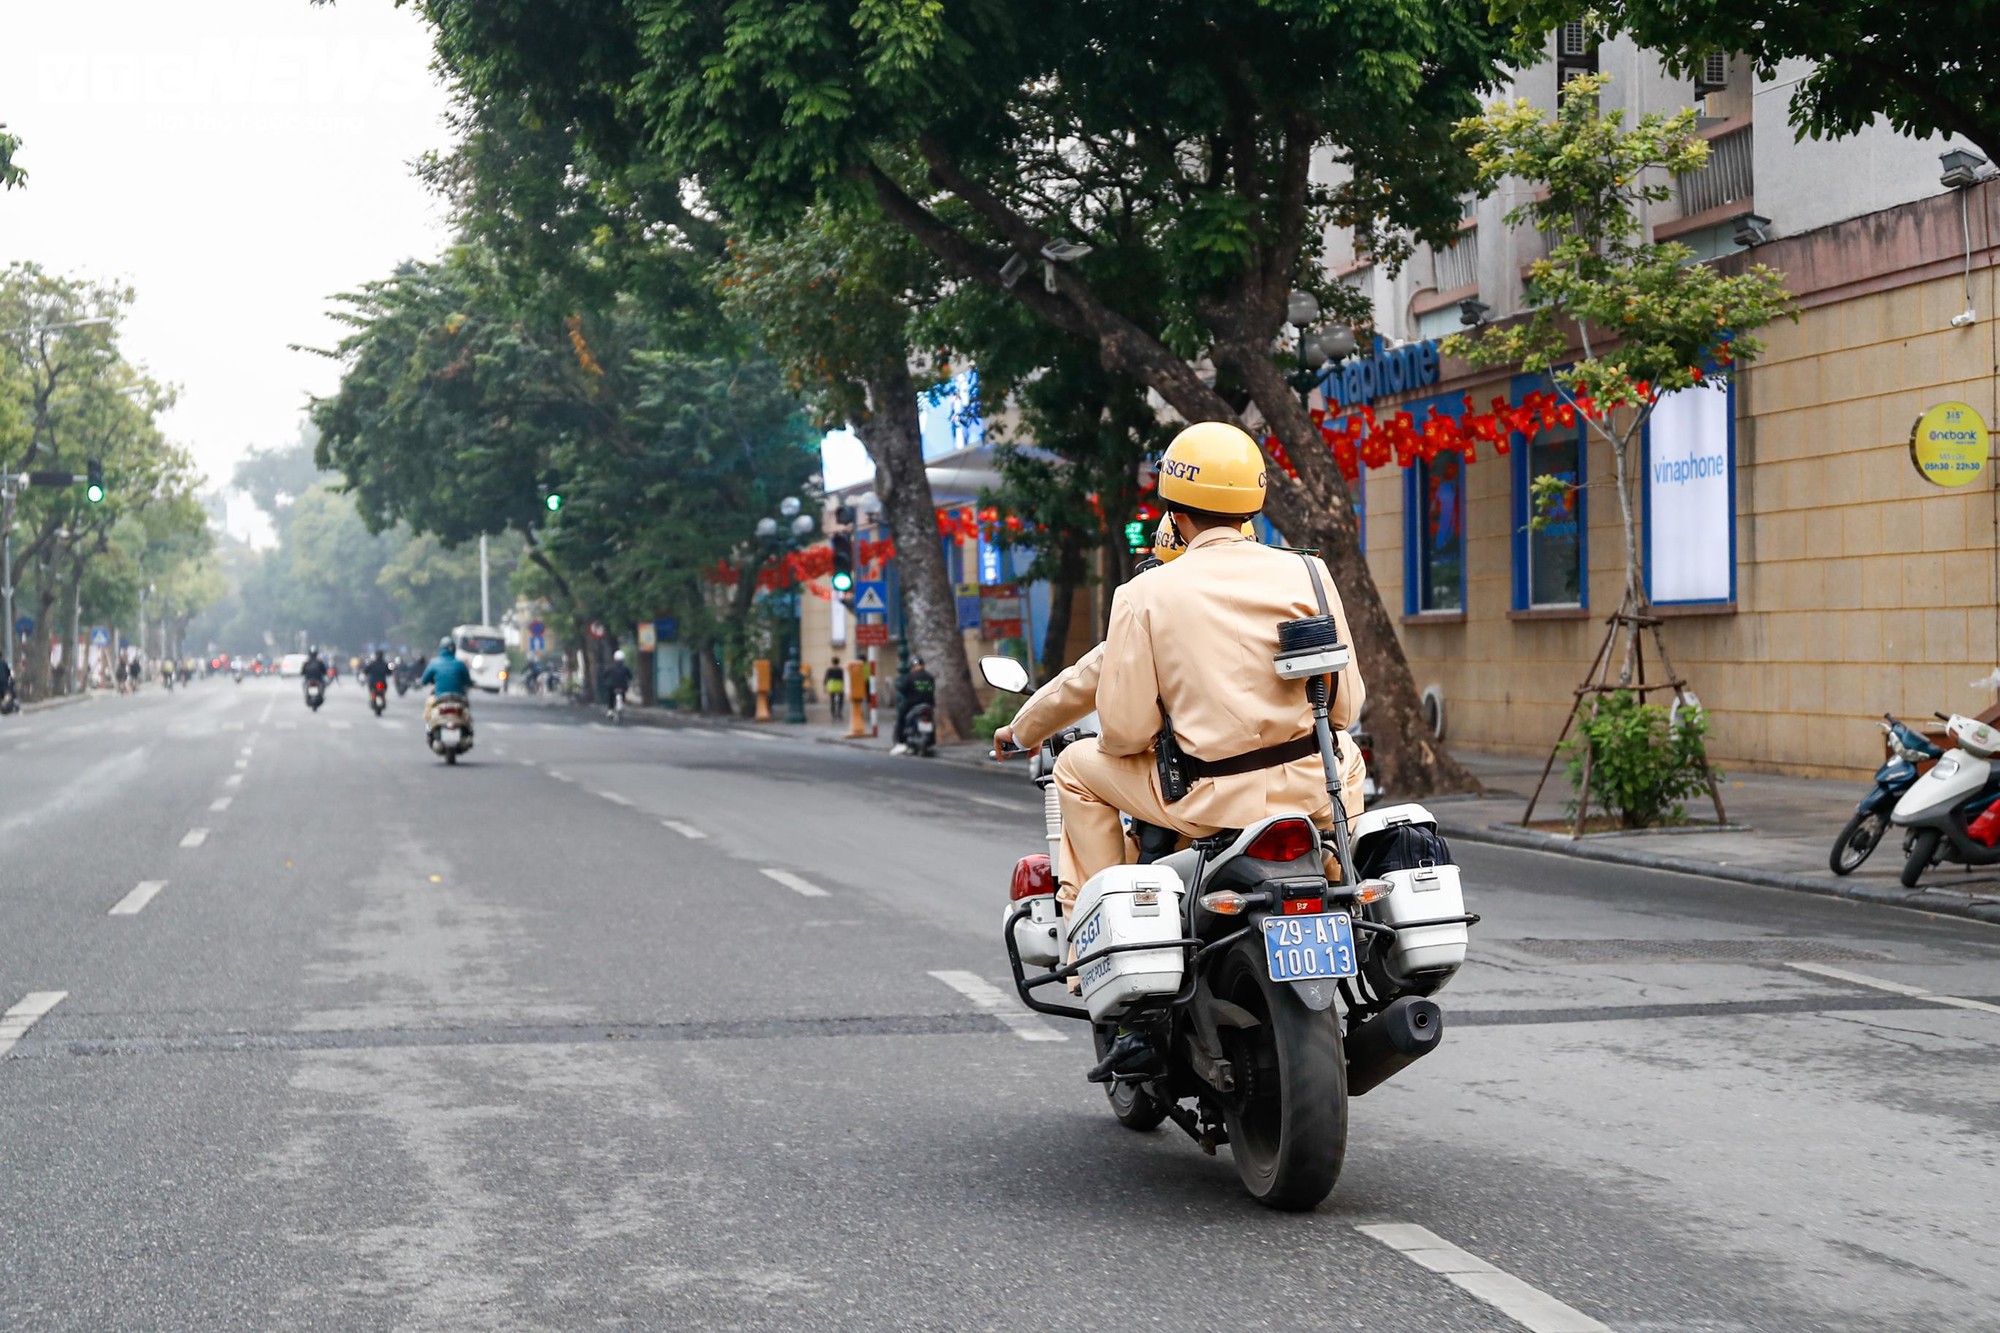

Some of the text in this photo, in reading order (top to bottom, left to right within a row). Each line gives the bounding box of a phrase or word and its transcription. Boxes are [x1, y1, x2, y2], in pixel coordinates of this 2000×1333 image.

[1317, 335, 1439, 409] vinaphone
[1654, 450, 1724, 486] vinaphone
[1955, 462, 1981, 471] 22h30
[1276, 917, 1339, 946] 29-A1
[1094, 957, 1112, 979] POLICE
[1275, 945, 1351, 977] 100.13
